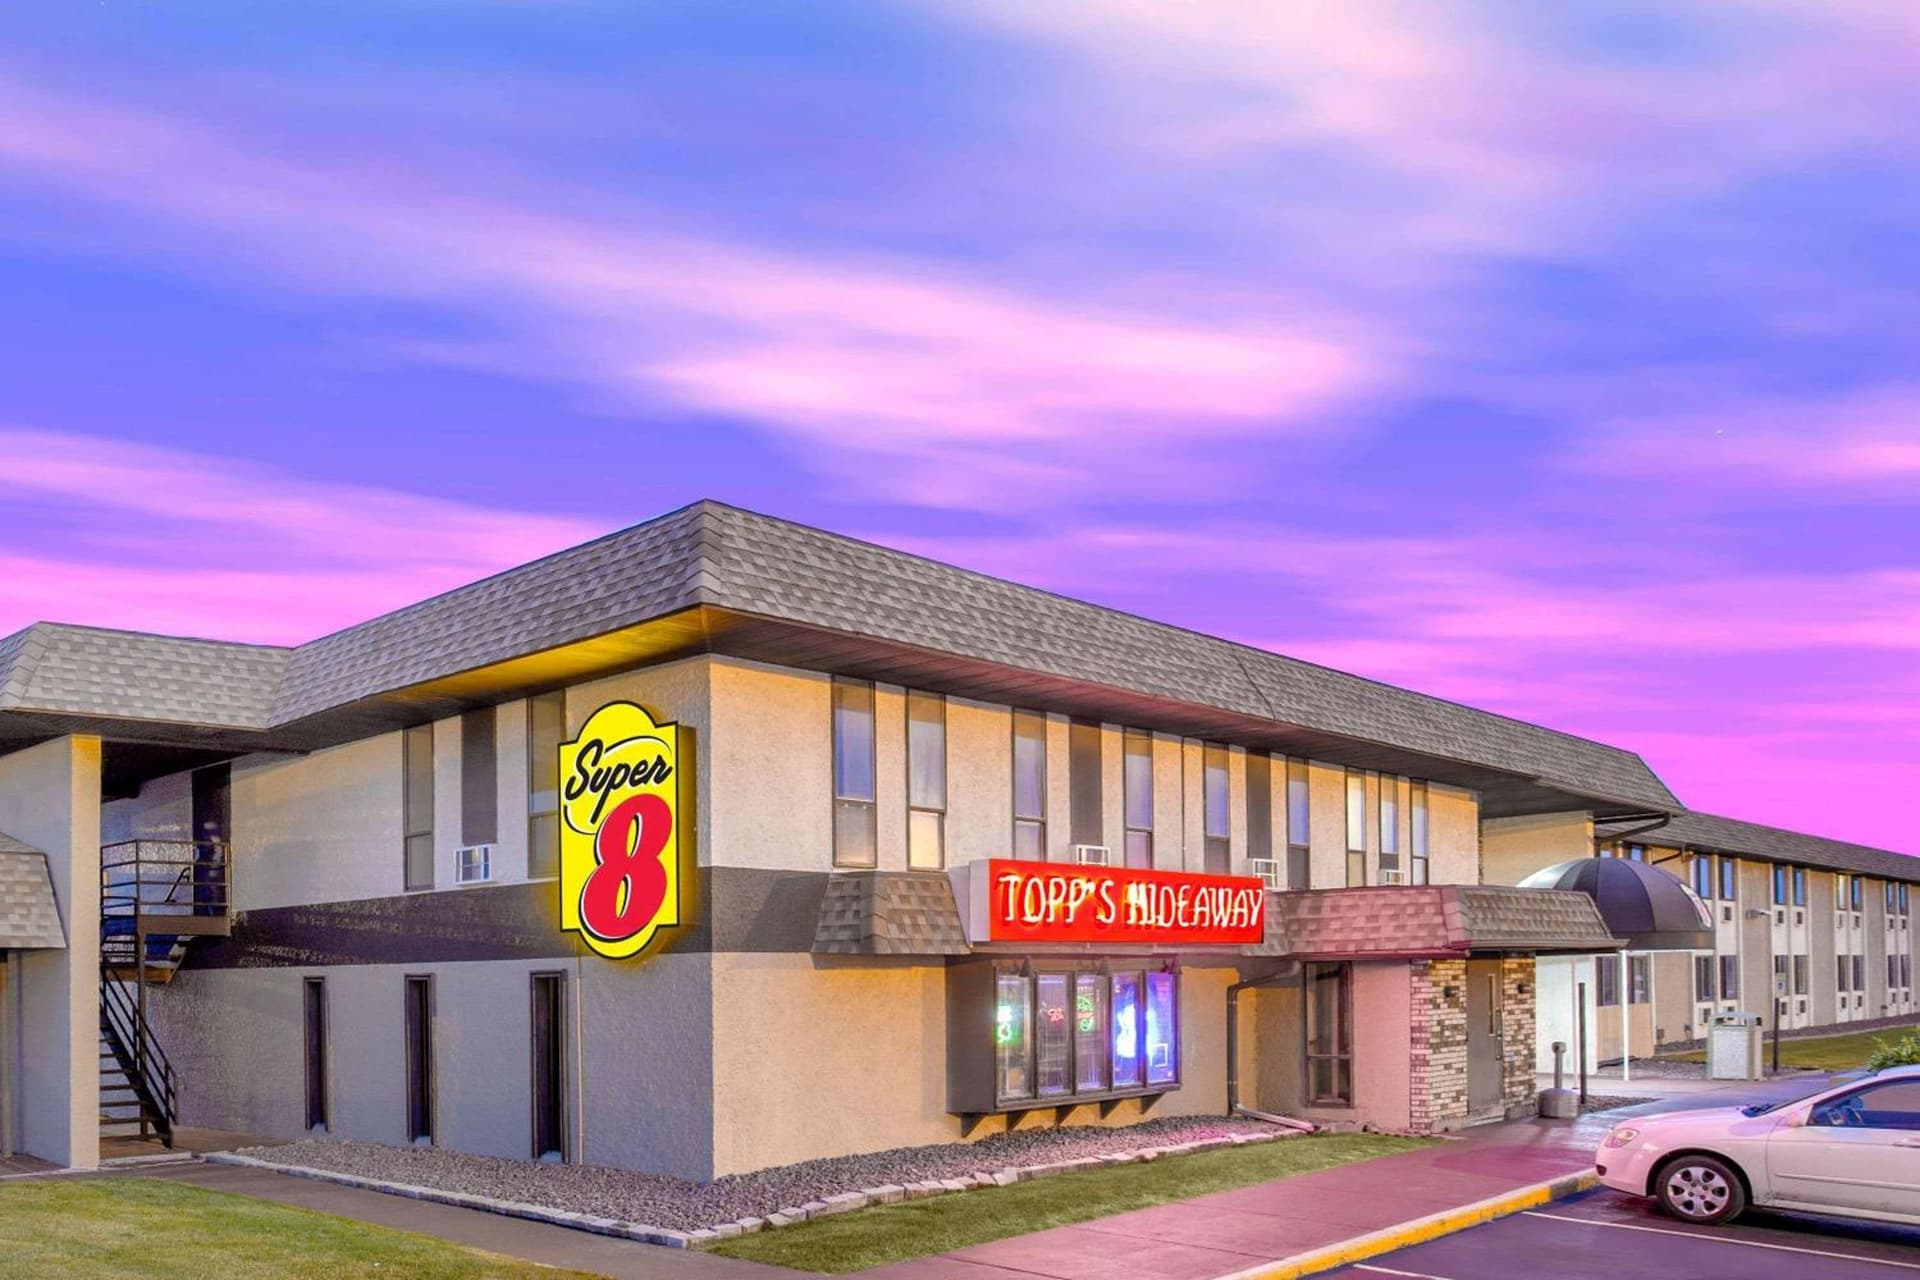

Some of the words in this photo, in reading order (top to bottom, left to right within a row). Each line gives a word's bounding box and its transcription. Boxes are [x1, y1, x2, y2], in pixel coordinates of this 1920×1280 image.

[565, 738, 673, 824] Super
[579, 793, 673, 942] 8
[998, 874, 1116, 924] TOPP'S
[1126, 882, 1264, 928] HIDEAWAY
